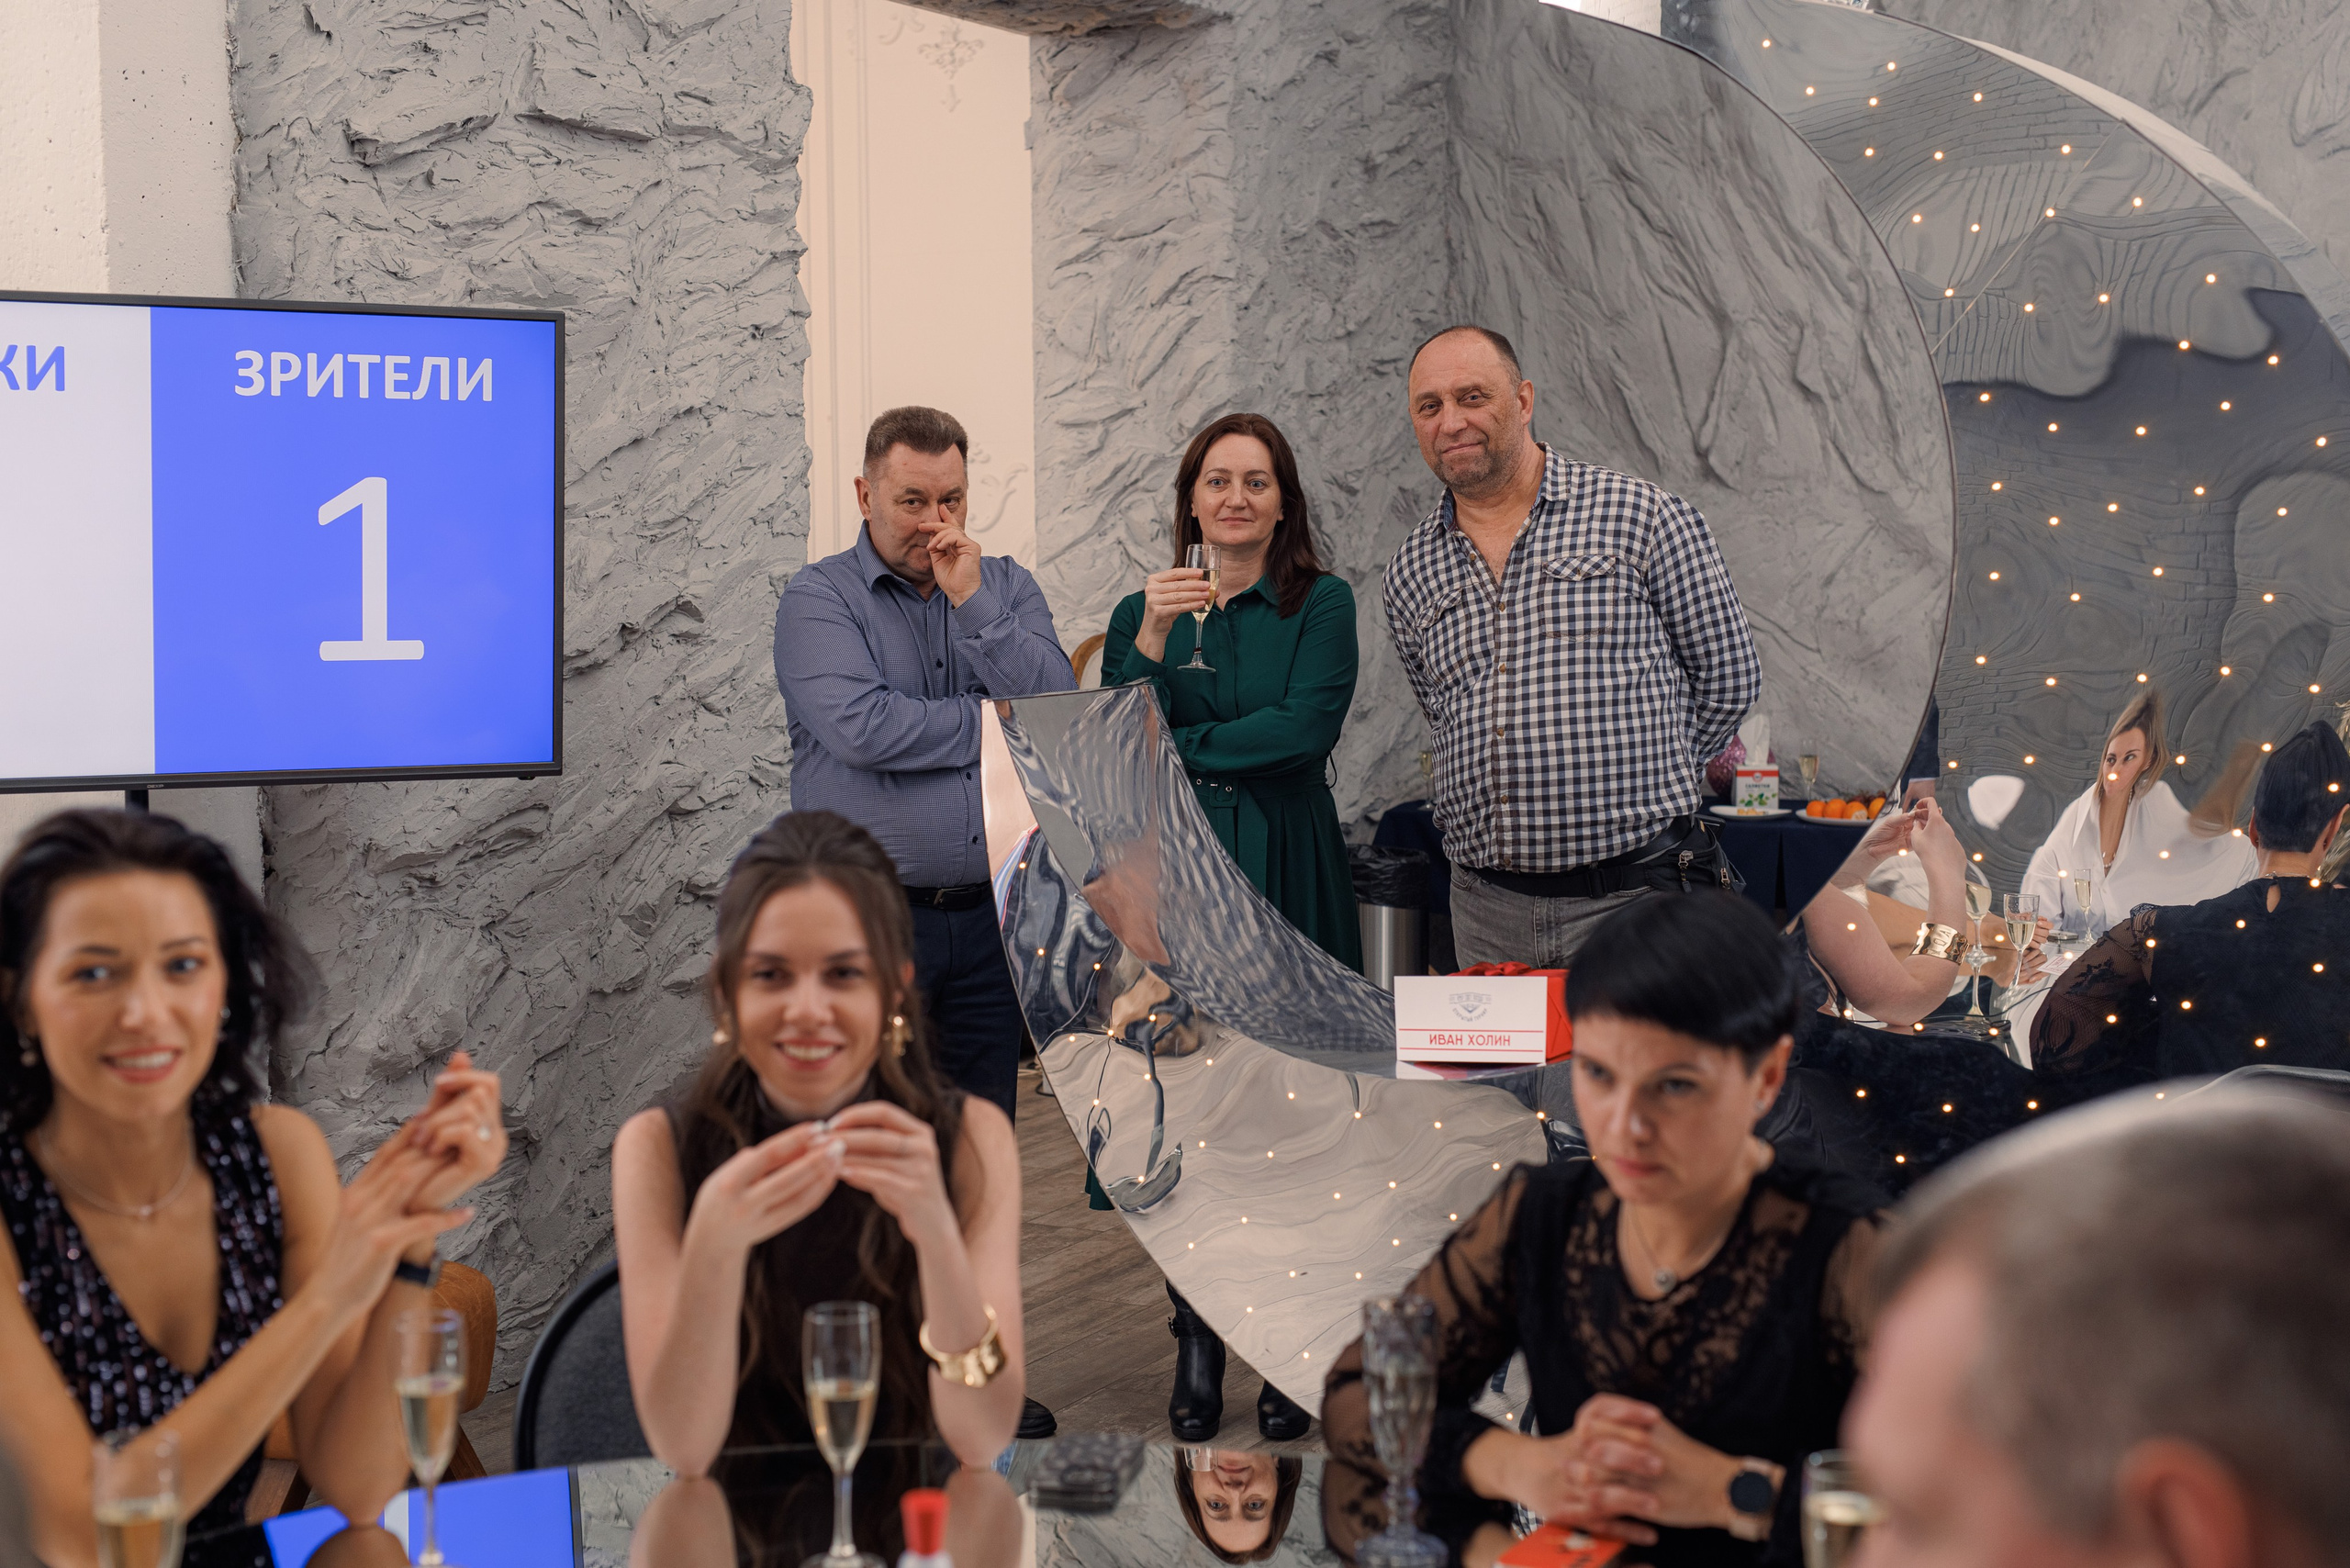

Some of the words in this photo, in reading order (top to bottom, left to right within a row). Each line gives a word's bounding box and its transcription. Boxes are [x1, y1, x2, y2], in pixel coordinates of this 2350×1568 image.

[234, 350, 493, 401] ЗРИТЕЛИ
[319, 476, 424, 661] 1
[1429, 1034, 1463, 1046] ИВАН
[1468, 1035, 1511, 1047] ХОЛИН
